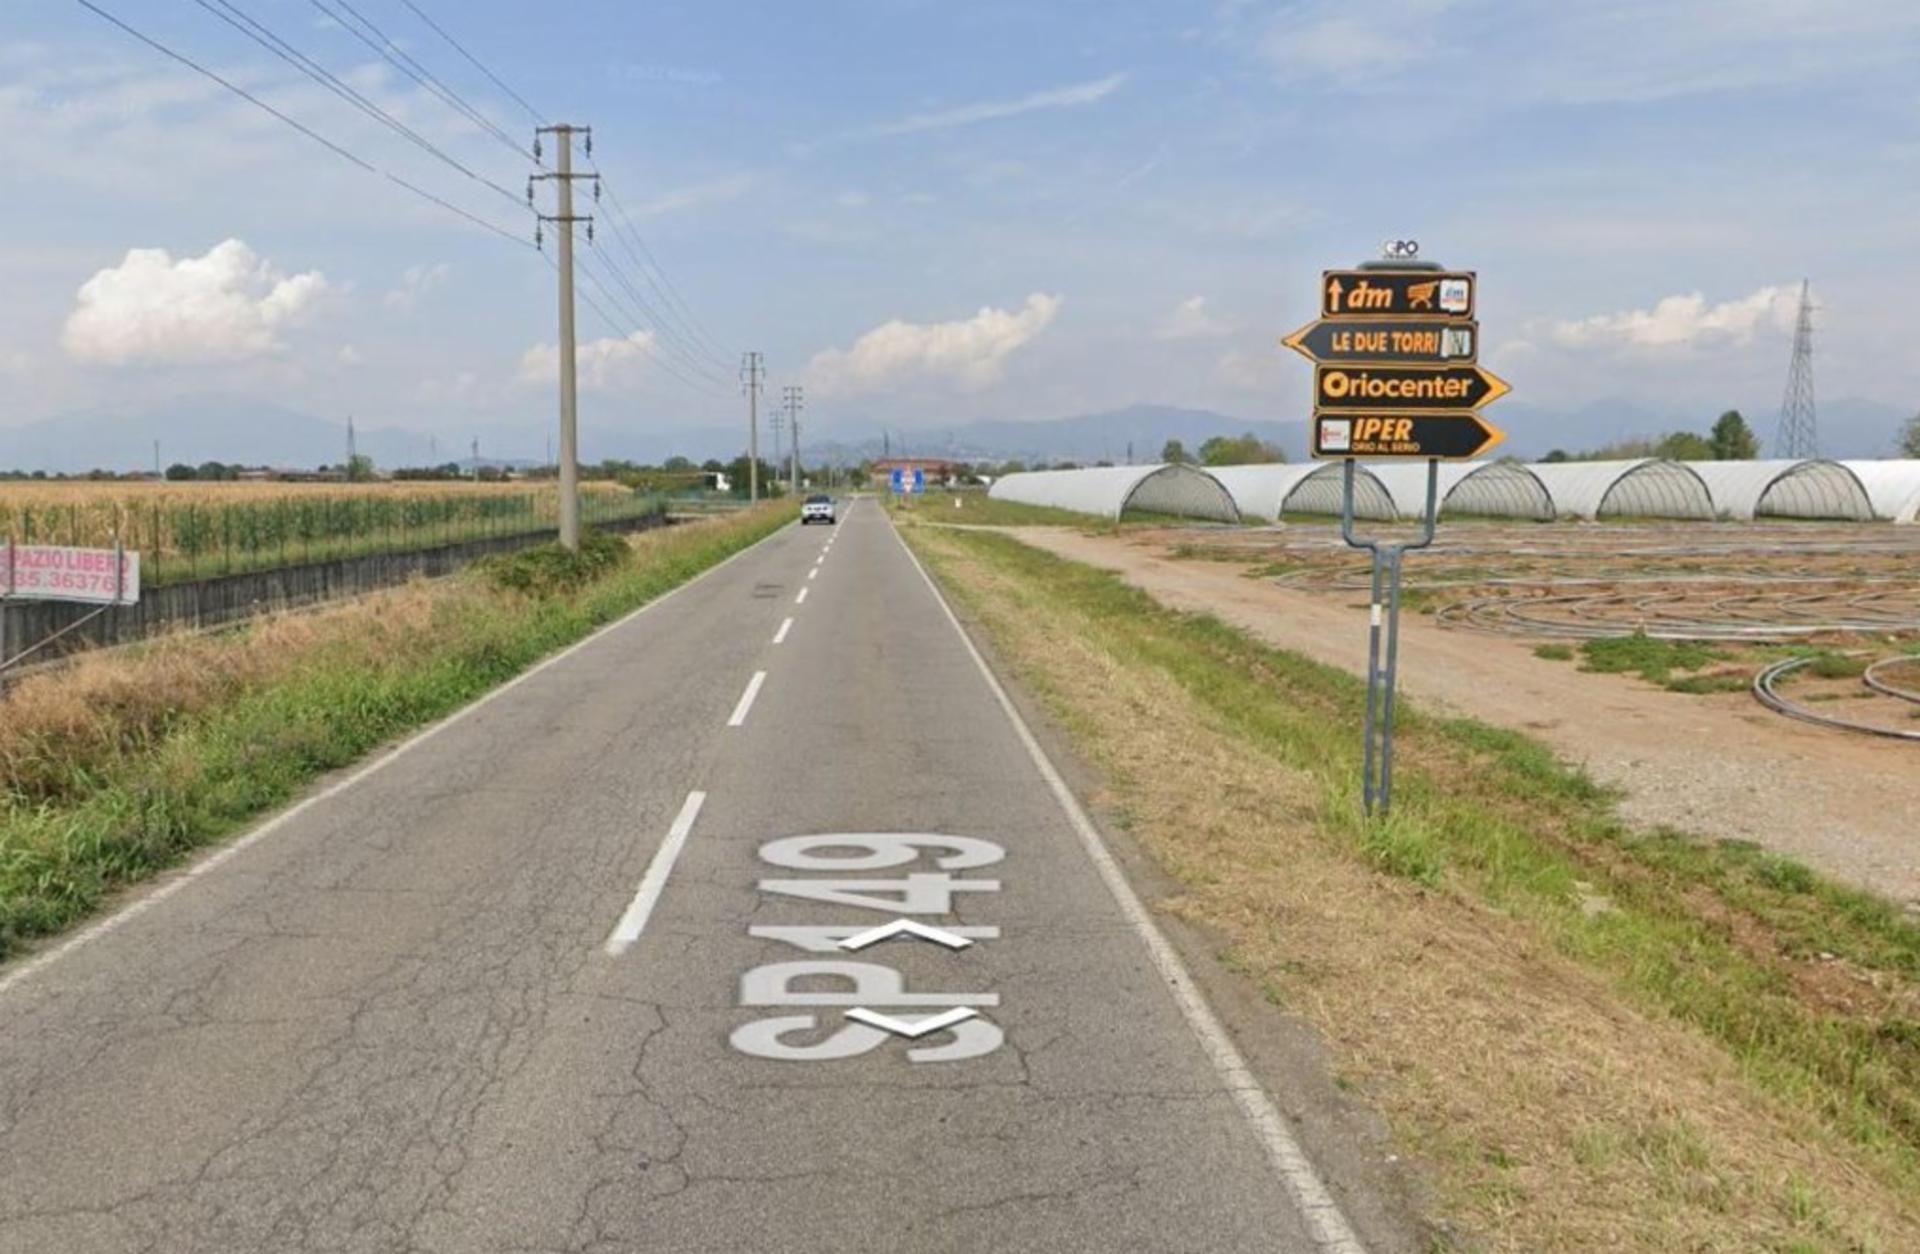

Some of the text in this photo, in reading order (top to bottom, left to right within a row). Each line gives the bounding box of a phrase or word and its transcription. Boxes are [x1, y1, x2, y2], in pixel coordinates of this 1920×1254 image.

[1347, 281, 1393, 308] dm
[1332, 332, 1439, 354] LE DUE TORRI
[1323, 371, 1473, 398] Oriocenter
[1353, 418, 1413, 441] IPER
